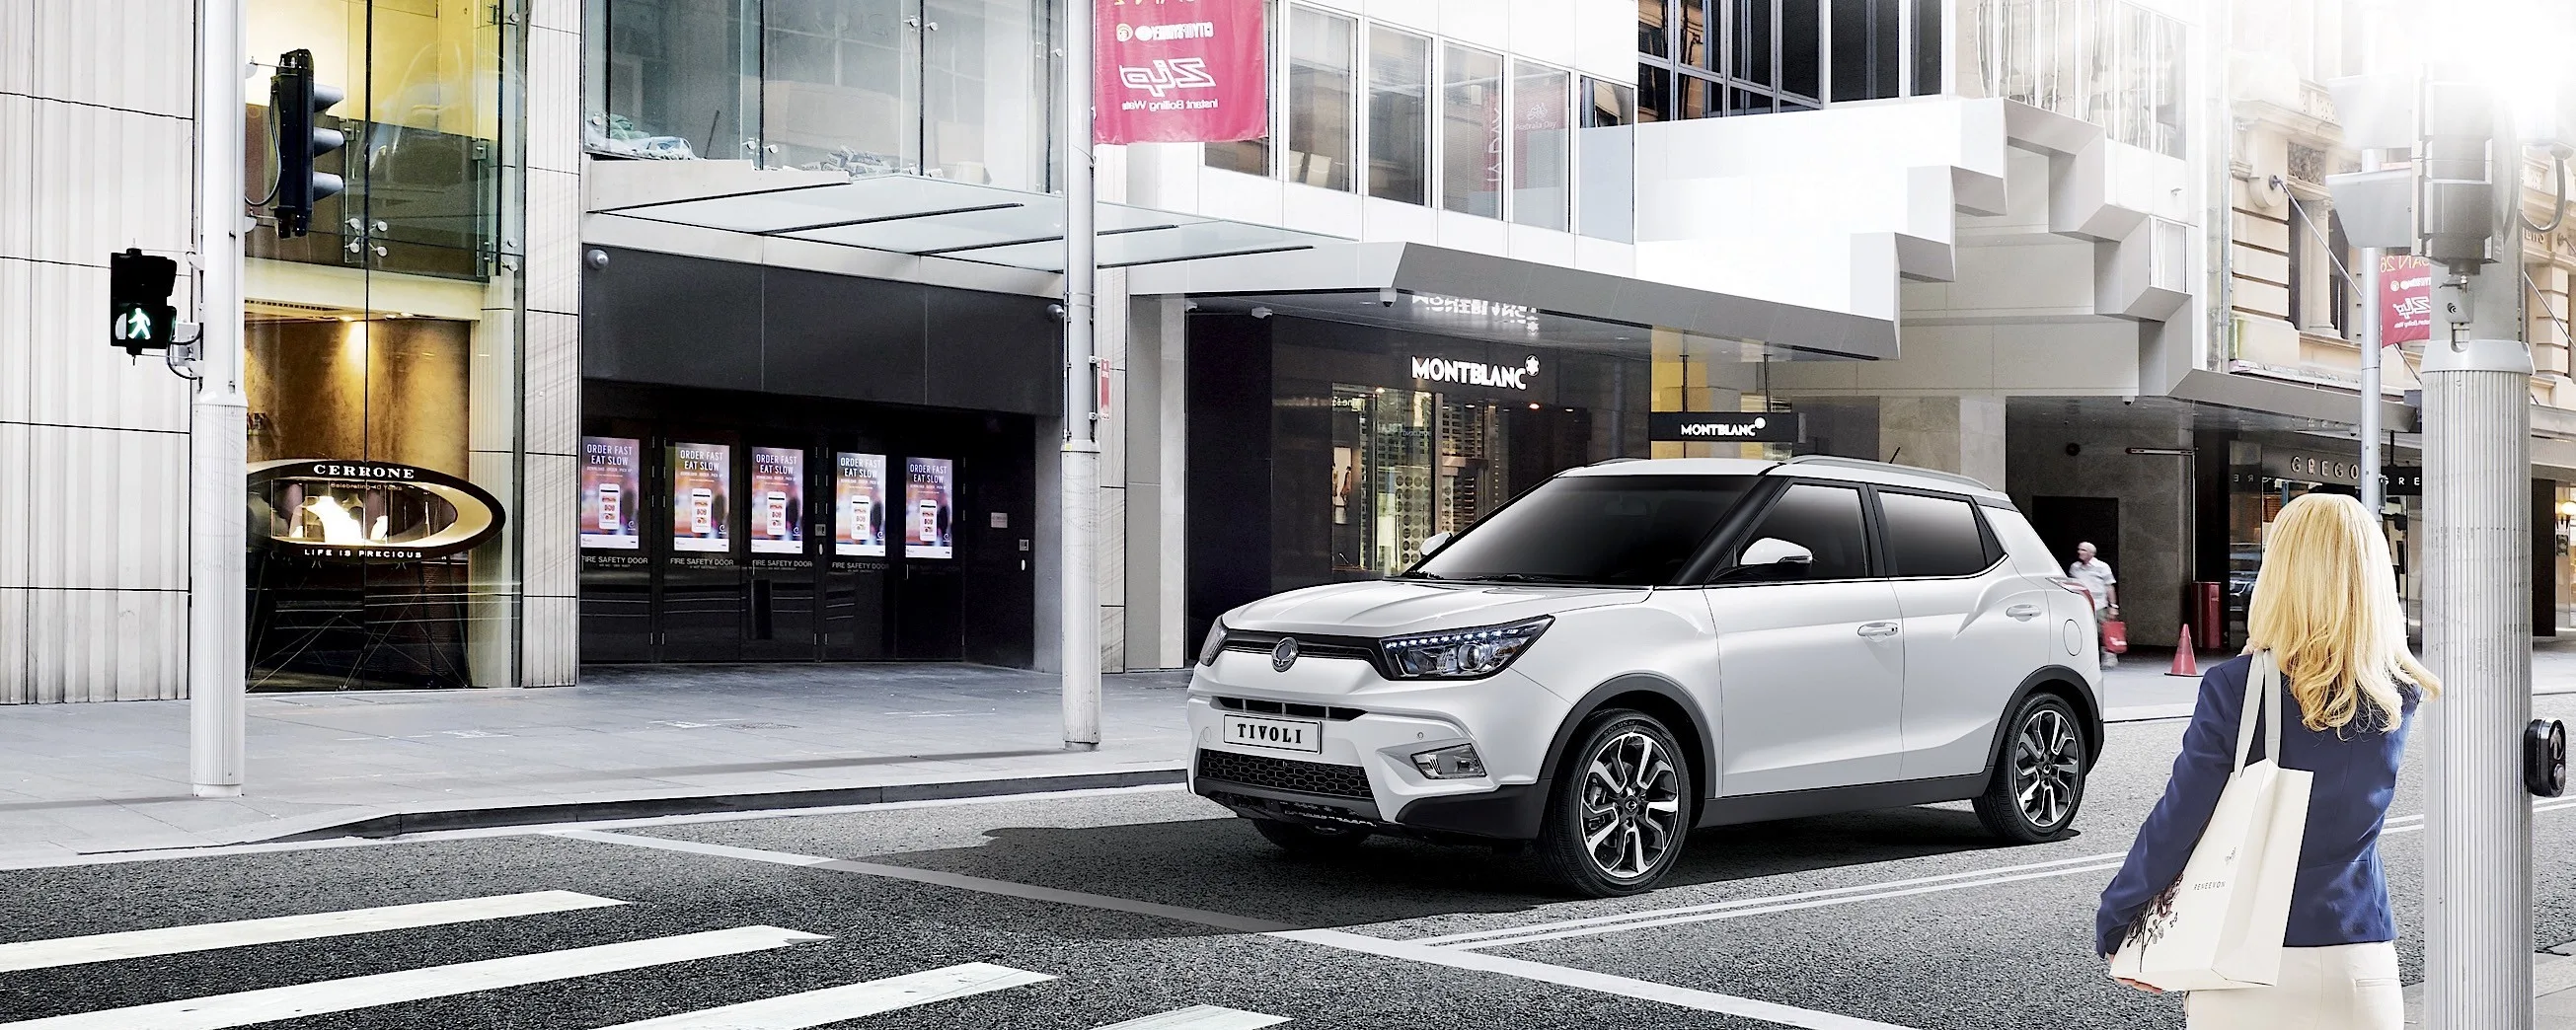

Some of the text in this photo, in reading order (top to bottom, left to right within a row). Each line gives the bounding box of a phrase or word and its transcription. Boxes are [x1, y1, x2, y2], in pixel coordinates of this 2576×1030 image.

[1411, 356, 1527, 390] MONTBLANC
[1681, 423, 1757, 437] MONTBLANC
[586, 444, 632, 456] ORDER FAST
[680, 450, 722, 460] ORDER FAST
[591, 456, 628, 466] EAT SLOW
[756, 454, 797, 465] ORDER FAST
[841, 458, 881, 468] ORDER FAST
[684, 461, 720, 471] EAT SLOW
[760, 465, 794, 475] EAT SLOW
[910, 465, 947, 475] ORDER FAST
[313, 464, 415, 479] CERRONE
[844, 468, 877, 478] EAT SLOW
[927, 475, 944, 483] SLOW
[358, 550, 422, 558] PRECIOUS
[1237, 723, 1302, 744] TIVOLI
